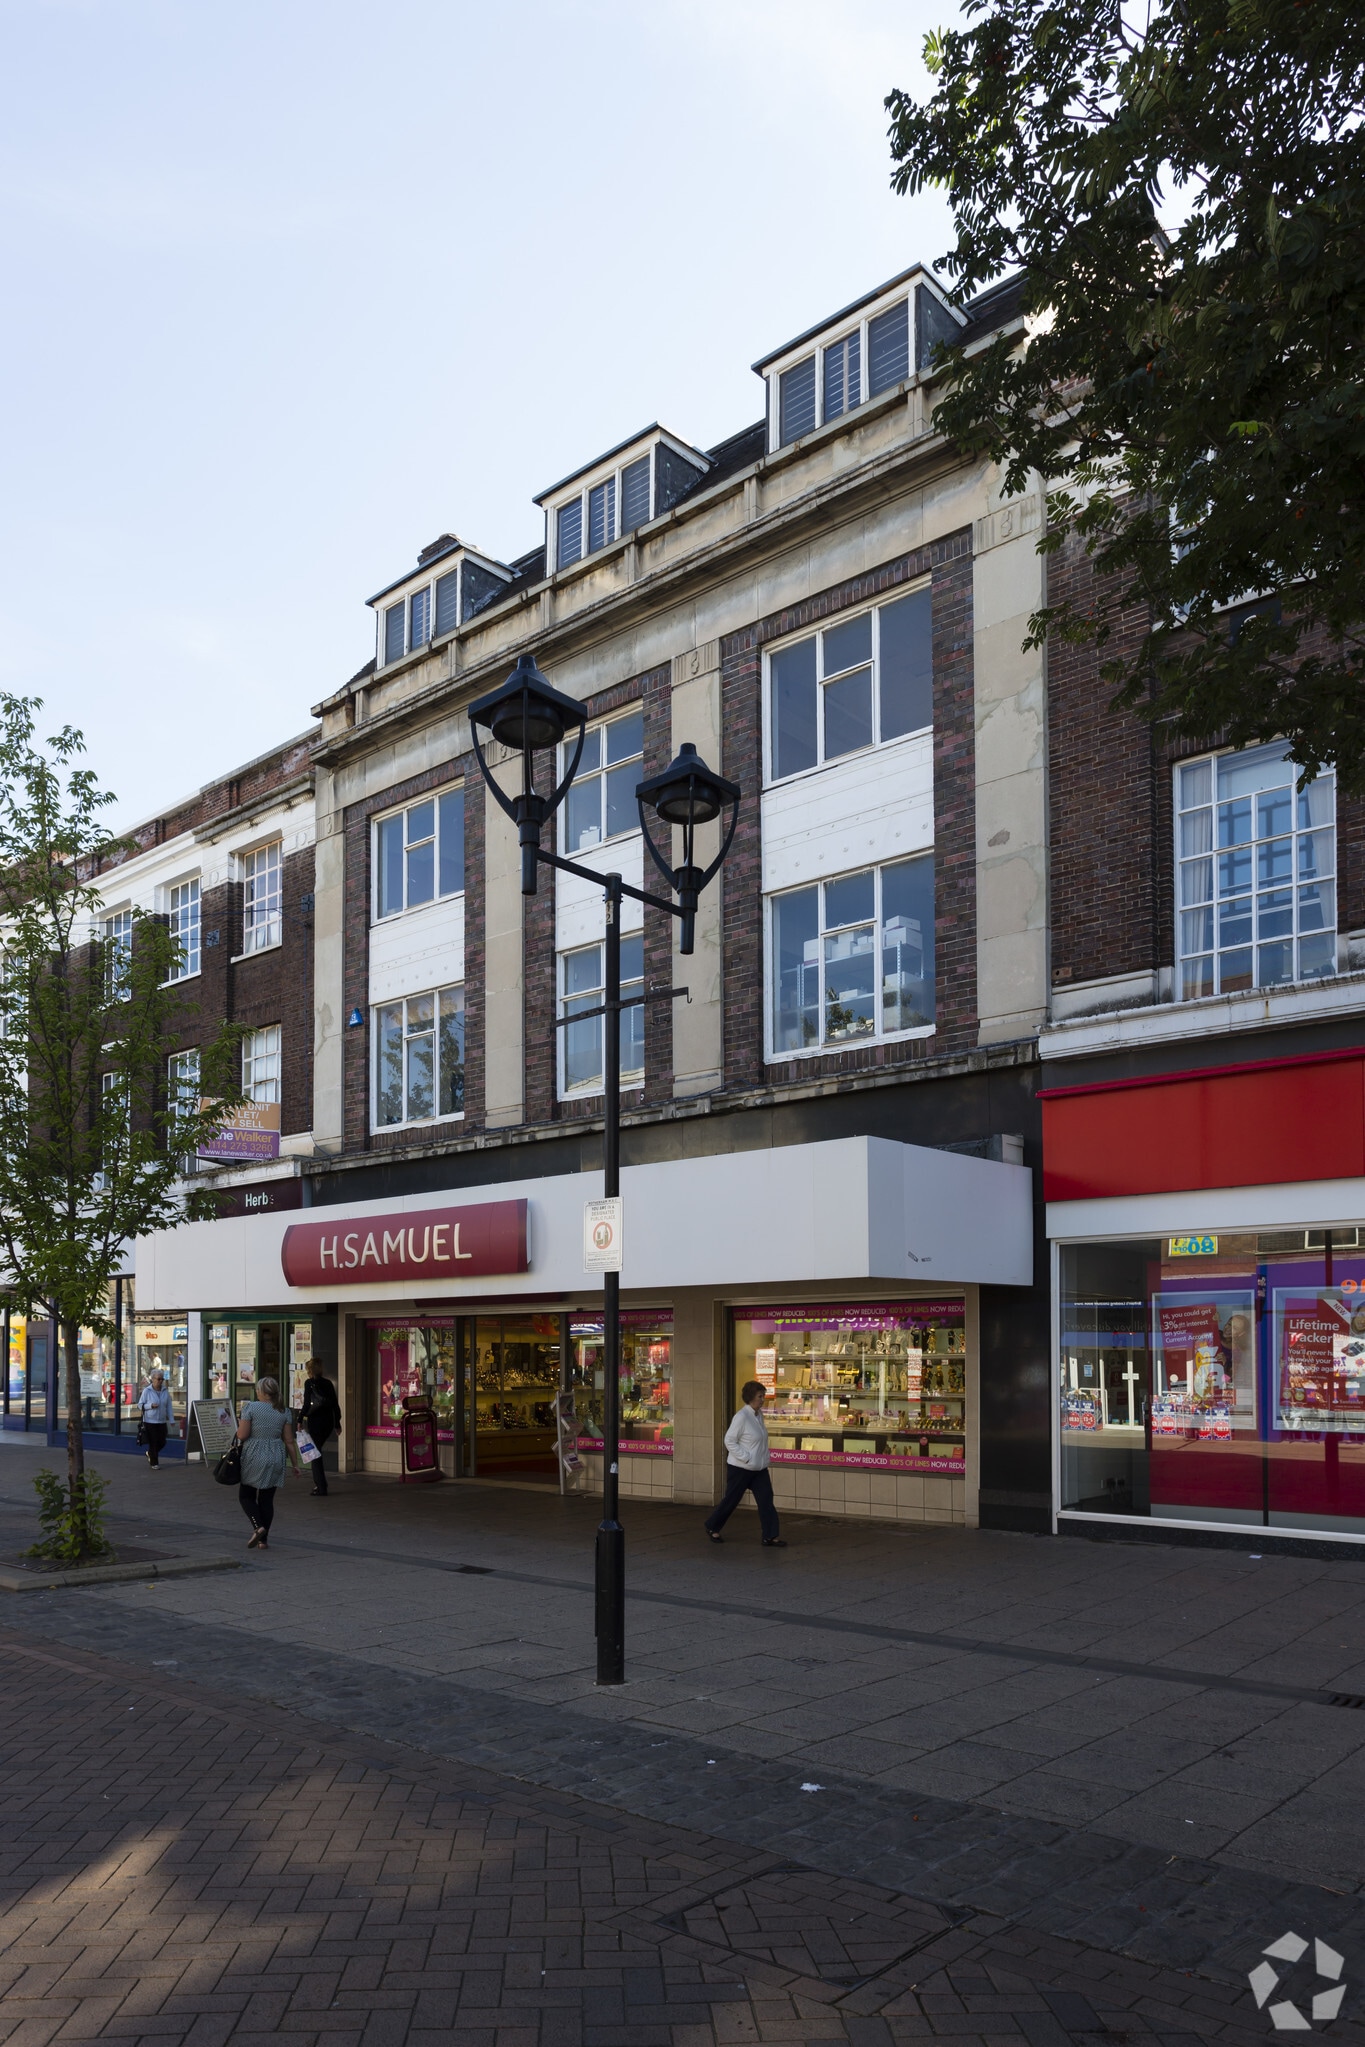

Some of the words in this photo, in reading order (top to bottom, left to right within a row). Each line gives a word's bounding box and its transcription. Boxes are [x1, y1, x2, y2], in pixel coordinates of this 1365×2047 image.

[248, 1103, 271, 1111] UNIT
[238, 1111, 259, 1119] LET/
[240, 1120, 264, 1128] SELL
[234, 1131, 273, 1143] Walker
[230, 1142, 247, 1150] 275
[250, 1143, 273, 1152] 3260
[204, 1149, 273, 1158] www.lanewalker.co.uk
[320, 1222, 472, 1269] H.SAMUEL
[1333, 1303, 1346, 1316] NEW
[1163, 1320, 1178, 1330] 3%
[1289, 1319, 1339, 1331] Lifetime
[1289, 1332, 1333, 1343] Tracker
[783, 1452, 807, 1460] REDUCED
[862, 1456, 888, 1465] REDUCED
[931, 1461, 947, 1469] NOW
